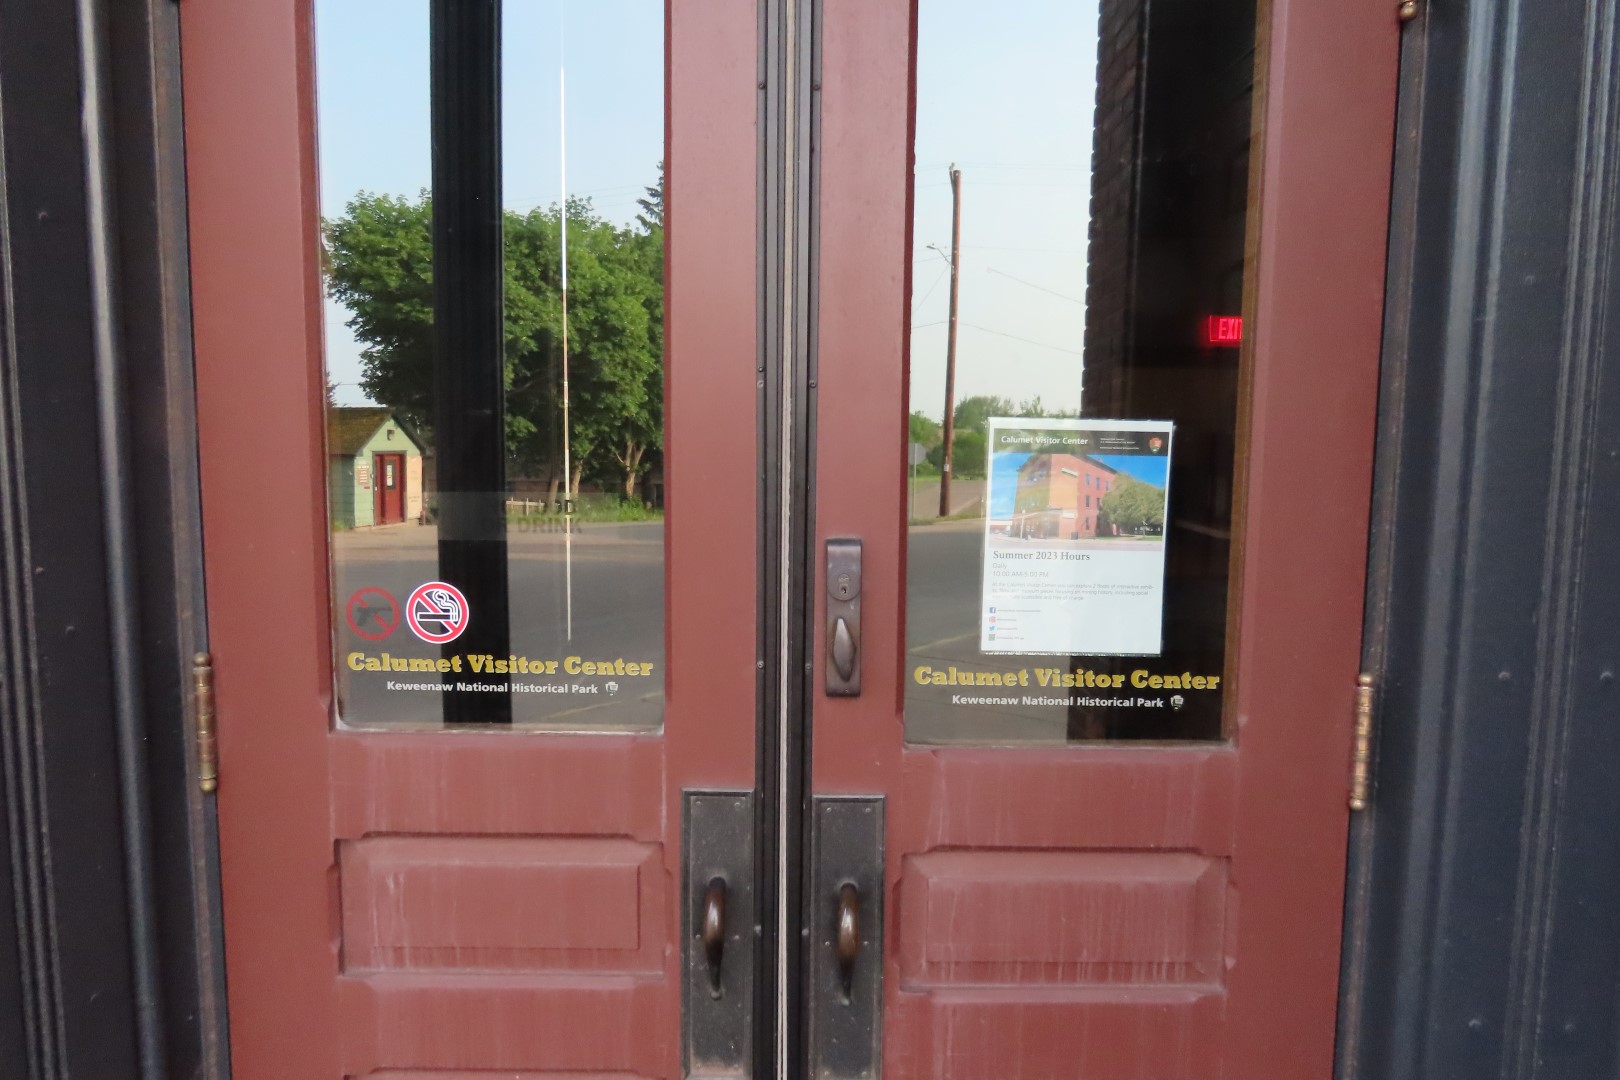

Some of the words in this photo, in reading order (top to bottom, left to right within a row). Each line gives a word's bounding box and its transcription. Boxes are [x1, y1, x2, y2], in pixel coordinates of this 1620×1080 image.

[1001, 435, 1033, 444] Calumet
[1035, 436, 1061, 444] Visitor
[1062, 437, 1088, 445] Center
[993, 550, 1033, 560] Summer
[1035, 551, 1058, 560] 2023
[1061, 551, 1090, 561] Hours
[992, 562, 1007, 570] Daily
[346, 651, 462, 673] Calumet
[467, 654, 558, 676] Visitor
[563, 656, 653, 677] Center
[914, 666, 1028, 686] Calumet
[1034, 668, 1126, 688] Visitor
[1130, 669, 1220, 690] Center
[387, 681, 453, 692] Keweenaw
[456, 681, 508, 693] National
[511, 682, 568, 694] Historical
[571, 683, 598, 694] Park
[952, 694, 1019, 705] Keweenaw
[1022, 694, 1073, 706] National
[1076, 695, 1134, 707] Historical
[1137, 697, 1164, 707] Park
